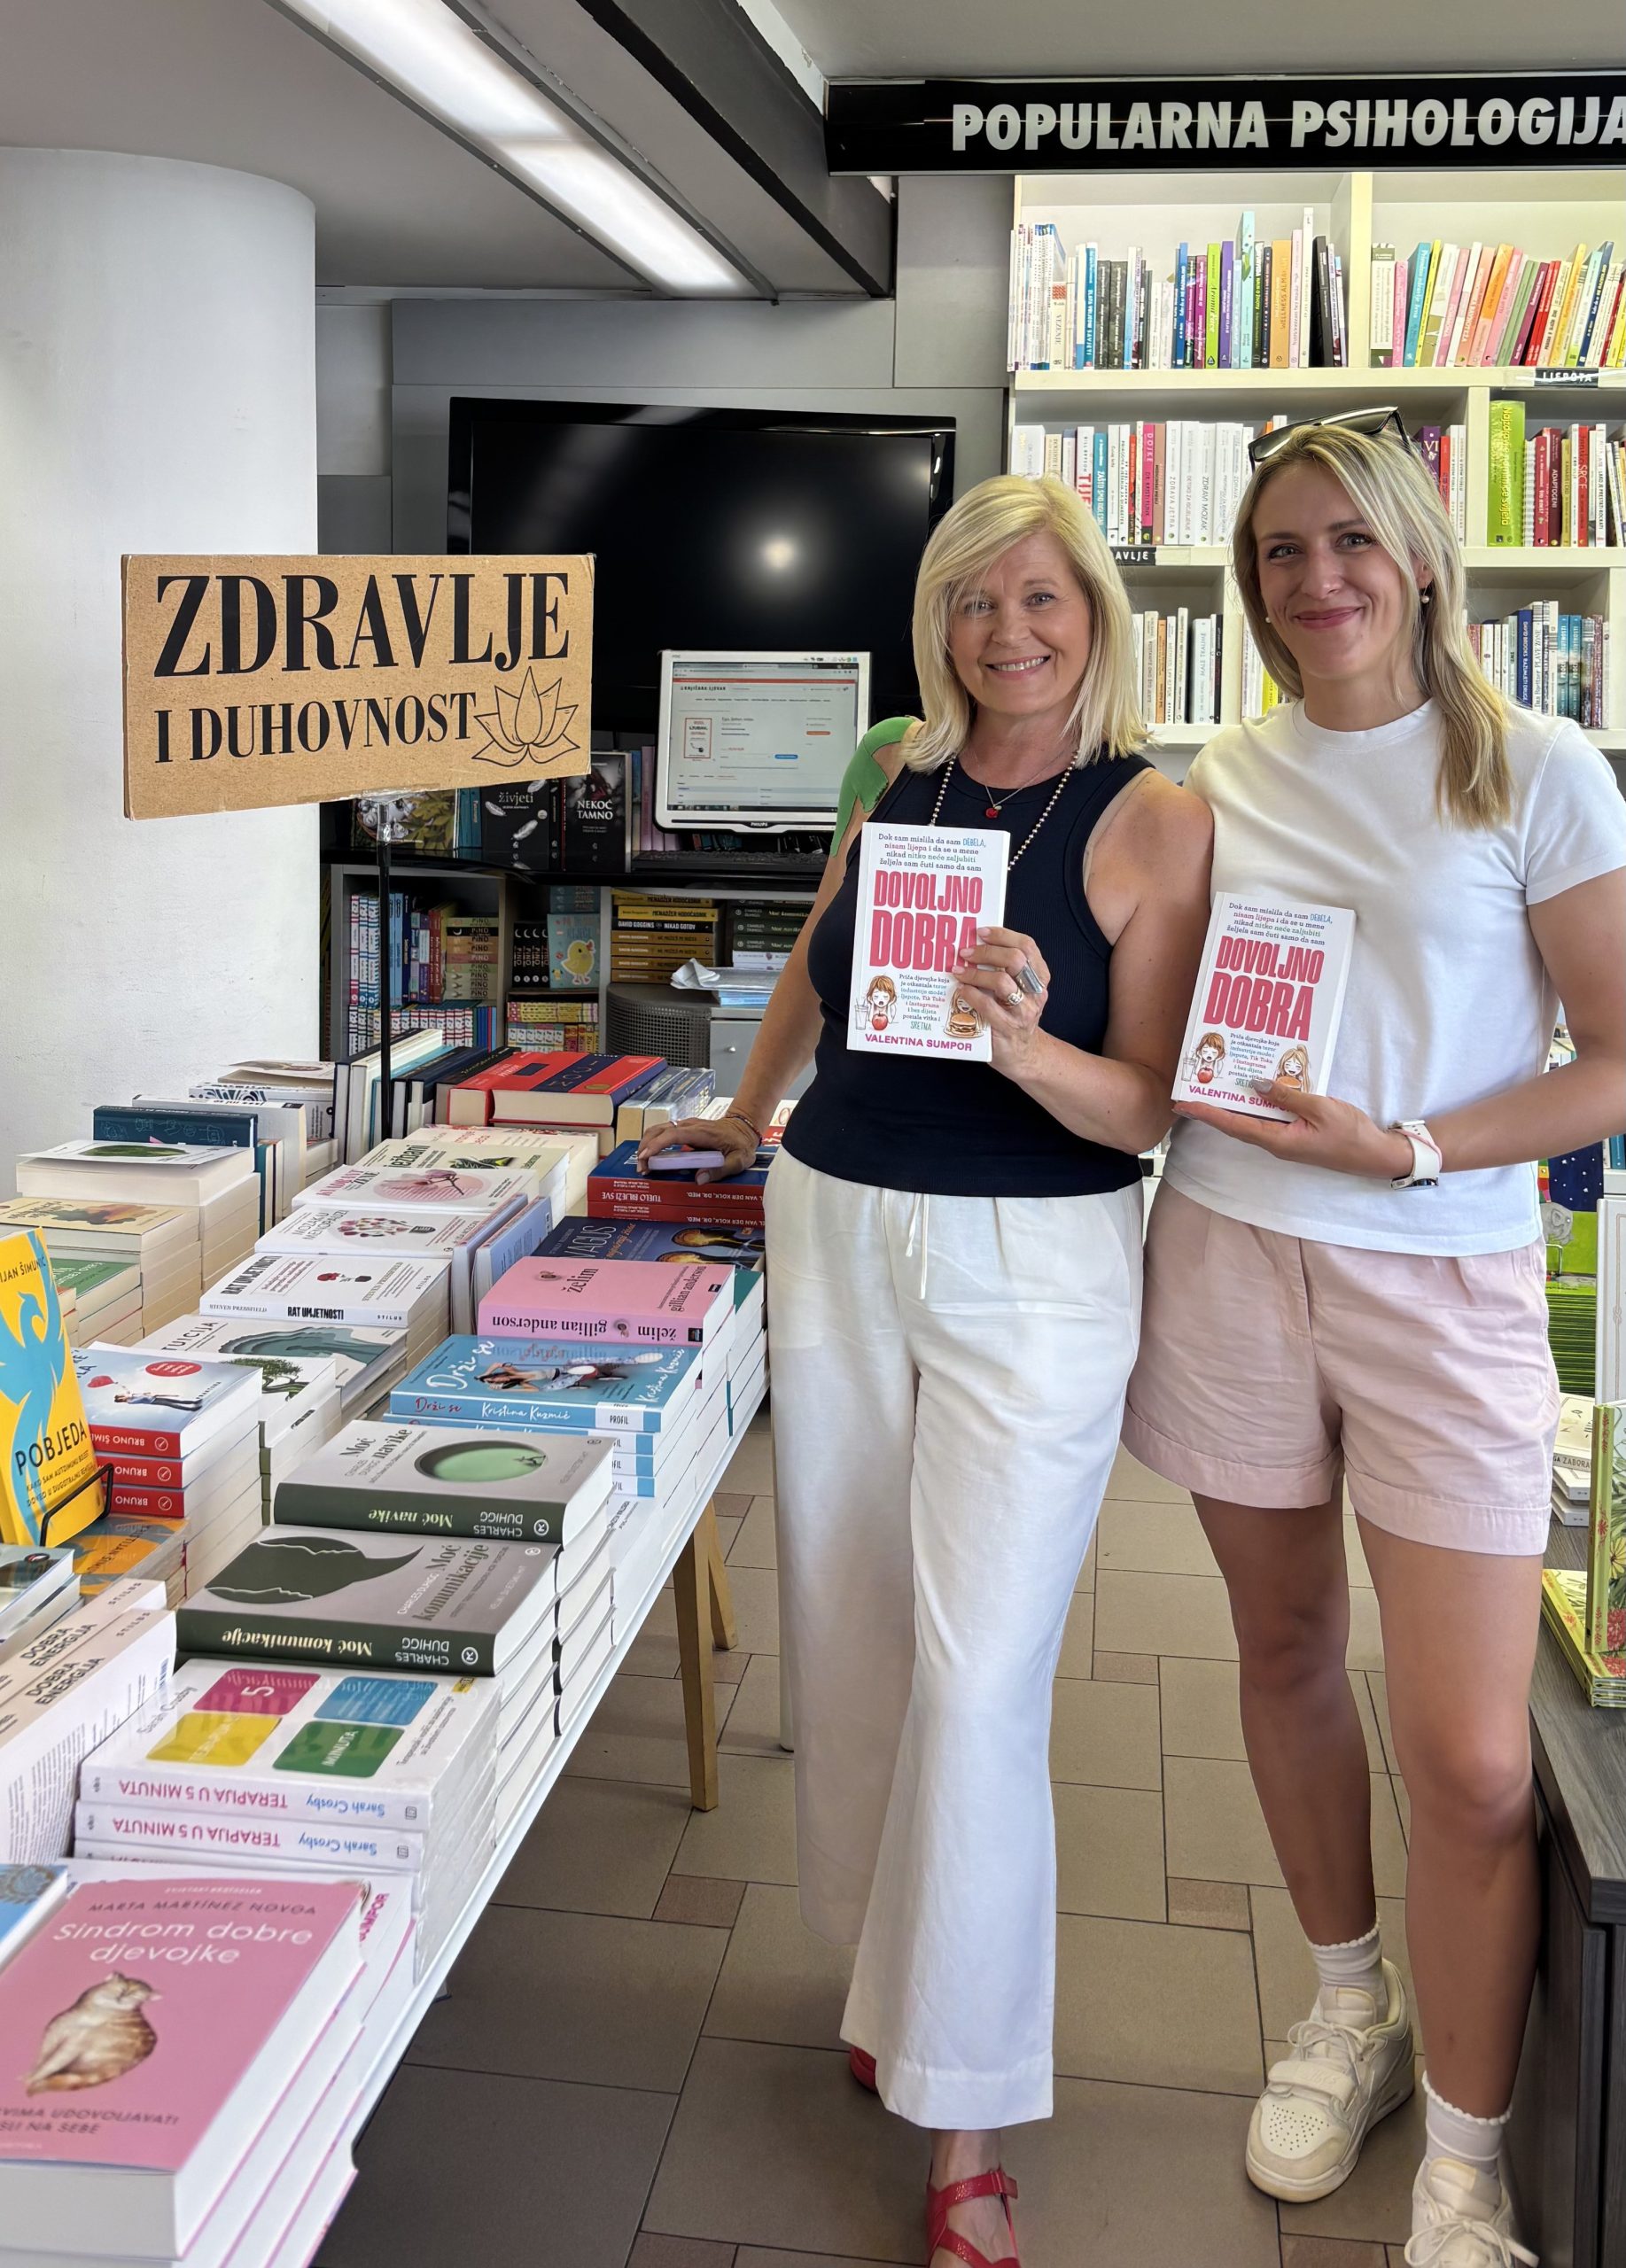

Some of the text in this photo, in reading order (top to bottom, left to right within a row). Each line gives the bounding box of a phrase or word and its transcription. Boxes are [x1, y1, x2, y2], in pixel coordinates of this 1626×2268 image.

[953, 96, 1626, 151] POPULARNA PSIHOLOGIJA
[1116, 551, 1149, 562] AVLJE
[154, 573, 570, 677] ZDRAVLJE
[154, 692, 476, 763] I DUHOVNOST
[499, 792, 533, 804] živjeti
[578, 798, 613, 810] NEKOĆ
[578, 810, 613, 820] TAMNO
[907, 843, 927, 852] lijepa
[963, 838, 986, 848] DEBELA,
[880, 858, 902, 866] željela
[946, 854, 976, 863] zaljubiti
[873, 869, 983, 913] DOVOLJNO
[1260, 907, 1283, 916] mislila
[1310, 913, 1333, 924] DEBELA,
[869, 909, 978, 974] DOBRA
[1215, 936, 1325, 984] DOVOLJNO
[1202, 971, 1314, 1042] DOBRA
[865, 1033, 972, 1052] VALENTINA SUMPOR
[1188, 1085, 1246, 1104] VALENTINA
[615, 1192, 639, 1202] BILJEŽI
[640, 1193, 662, 1202] TIJELO
[564, 1225, 617, 1258] VAGUS
[0, 1256, 46, 1282] IJAN ŠIMUNIĆ
[235, 1255, 283, 1283] UMJETNOSTI
[561, 1268, 599, 1293] želim
[287, 1306, 300, 1317] RAT
[301, 1307, 344, 1320] UMJETNOSTI
[160, 1322, 219, 1351] TUICIJA
[492, 1315, 677, 1340] gillian anderson želim
[415, 1396, 447, 1413] Drži
[481, 1402, 528, 1418] Kristina
[529, 1405, 571, 1422] Kuzmić
[610, 1414, 630, 1425] PROFIL
[14, 1418, 88, 1476] POBJEDA
[113, 1437, 144, 1446] BRUNO
[371, 1429, 413, 1459] navike
[115, 1466, 147, 1477] BRUNO
[1563, 1456, 1590, 1469] ZABORA
[42, 1472, 54, 1485] SAM
[115, 1495, 148, 1505] BRUNO
[368, 1508, 454, 1528] Moć navike
[480, 1511, 524, 1526] DUHIGG
[473, 1524, 524, 1537] CHARLES
[424, 1544, 462, 1572] Moć
[412, 1543, 490, 1621] komunikacije
[19, 1627, 73, 1660] DOBRA
[28, 1623, 98, 1667] ENERGIJA
[221, 1628, 373, 1658] Moć komunikacije
[402, 1636, 450, 1652] DUHIGG
[395, 1651, 450, 1666] CHARLES
[25, 1661, 81, 1697] DOBRA
[35, 1656, 106, 1705] ENERGIJA
[321, 1728, 360, 1767] MINUTA
[119, 1779, 385, 1817] Sarah Crosby TERAPIJA U 5 MINUTA
[88, 1898, 317, 1915] MARTA MARTÍNEZ NOVOA
[206, 1921, 313, 1946] dobre
[89, 1944, 241, 1965] djevojke
